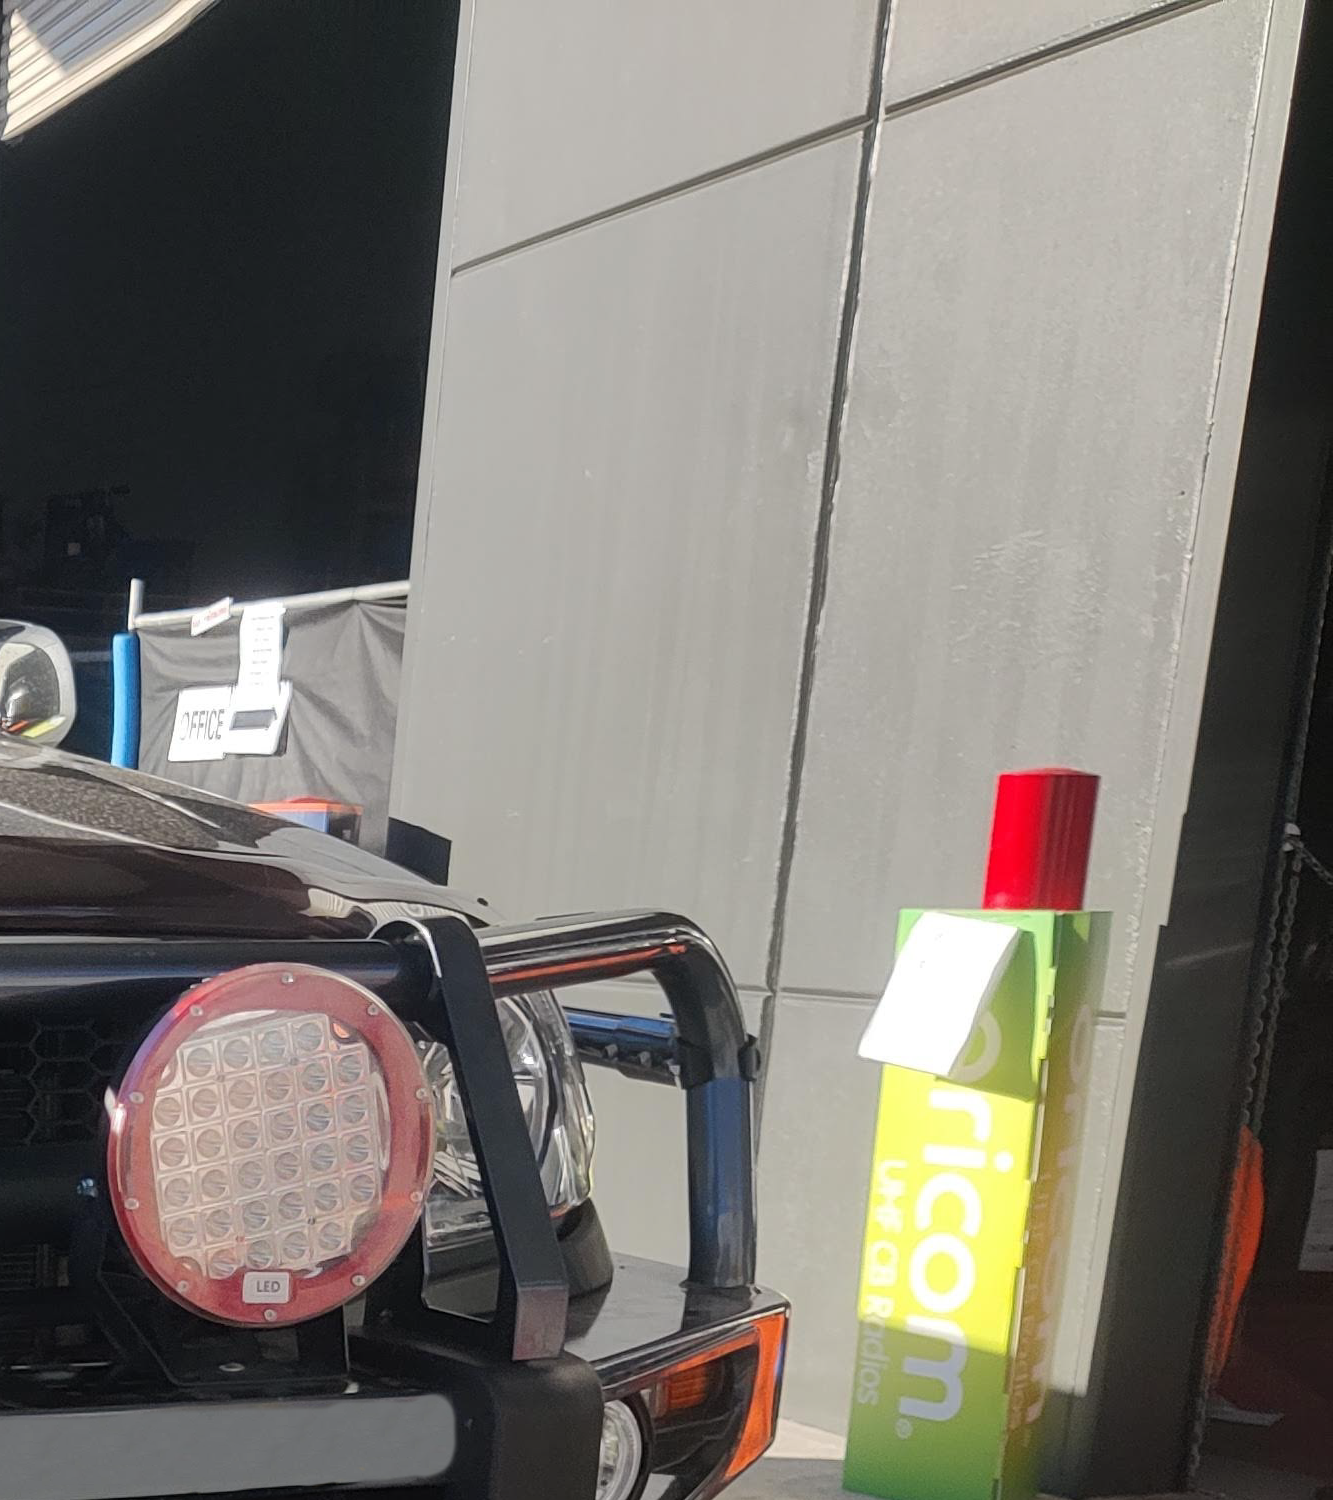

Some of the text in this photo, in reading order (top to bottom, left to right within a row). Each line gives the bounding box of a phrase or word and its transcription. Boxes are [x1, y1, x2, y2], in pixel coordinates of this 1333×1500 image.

[179, 708, 225, 741] OFFICE
[867, 1240, 900, 1287] CB
[256, 1280, 281, 1293] LED
[856, 1293, 895, 1405] Radios
